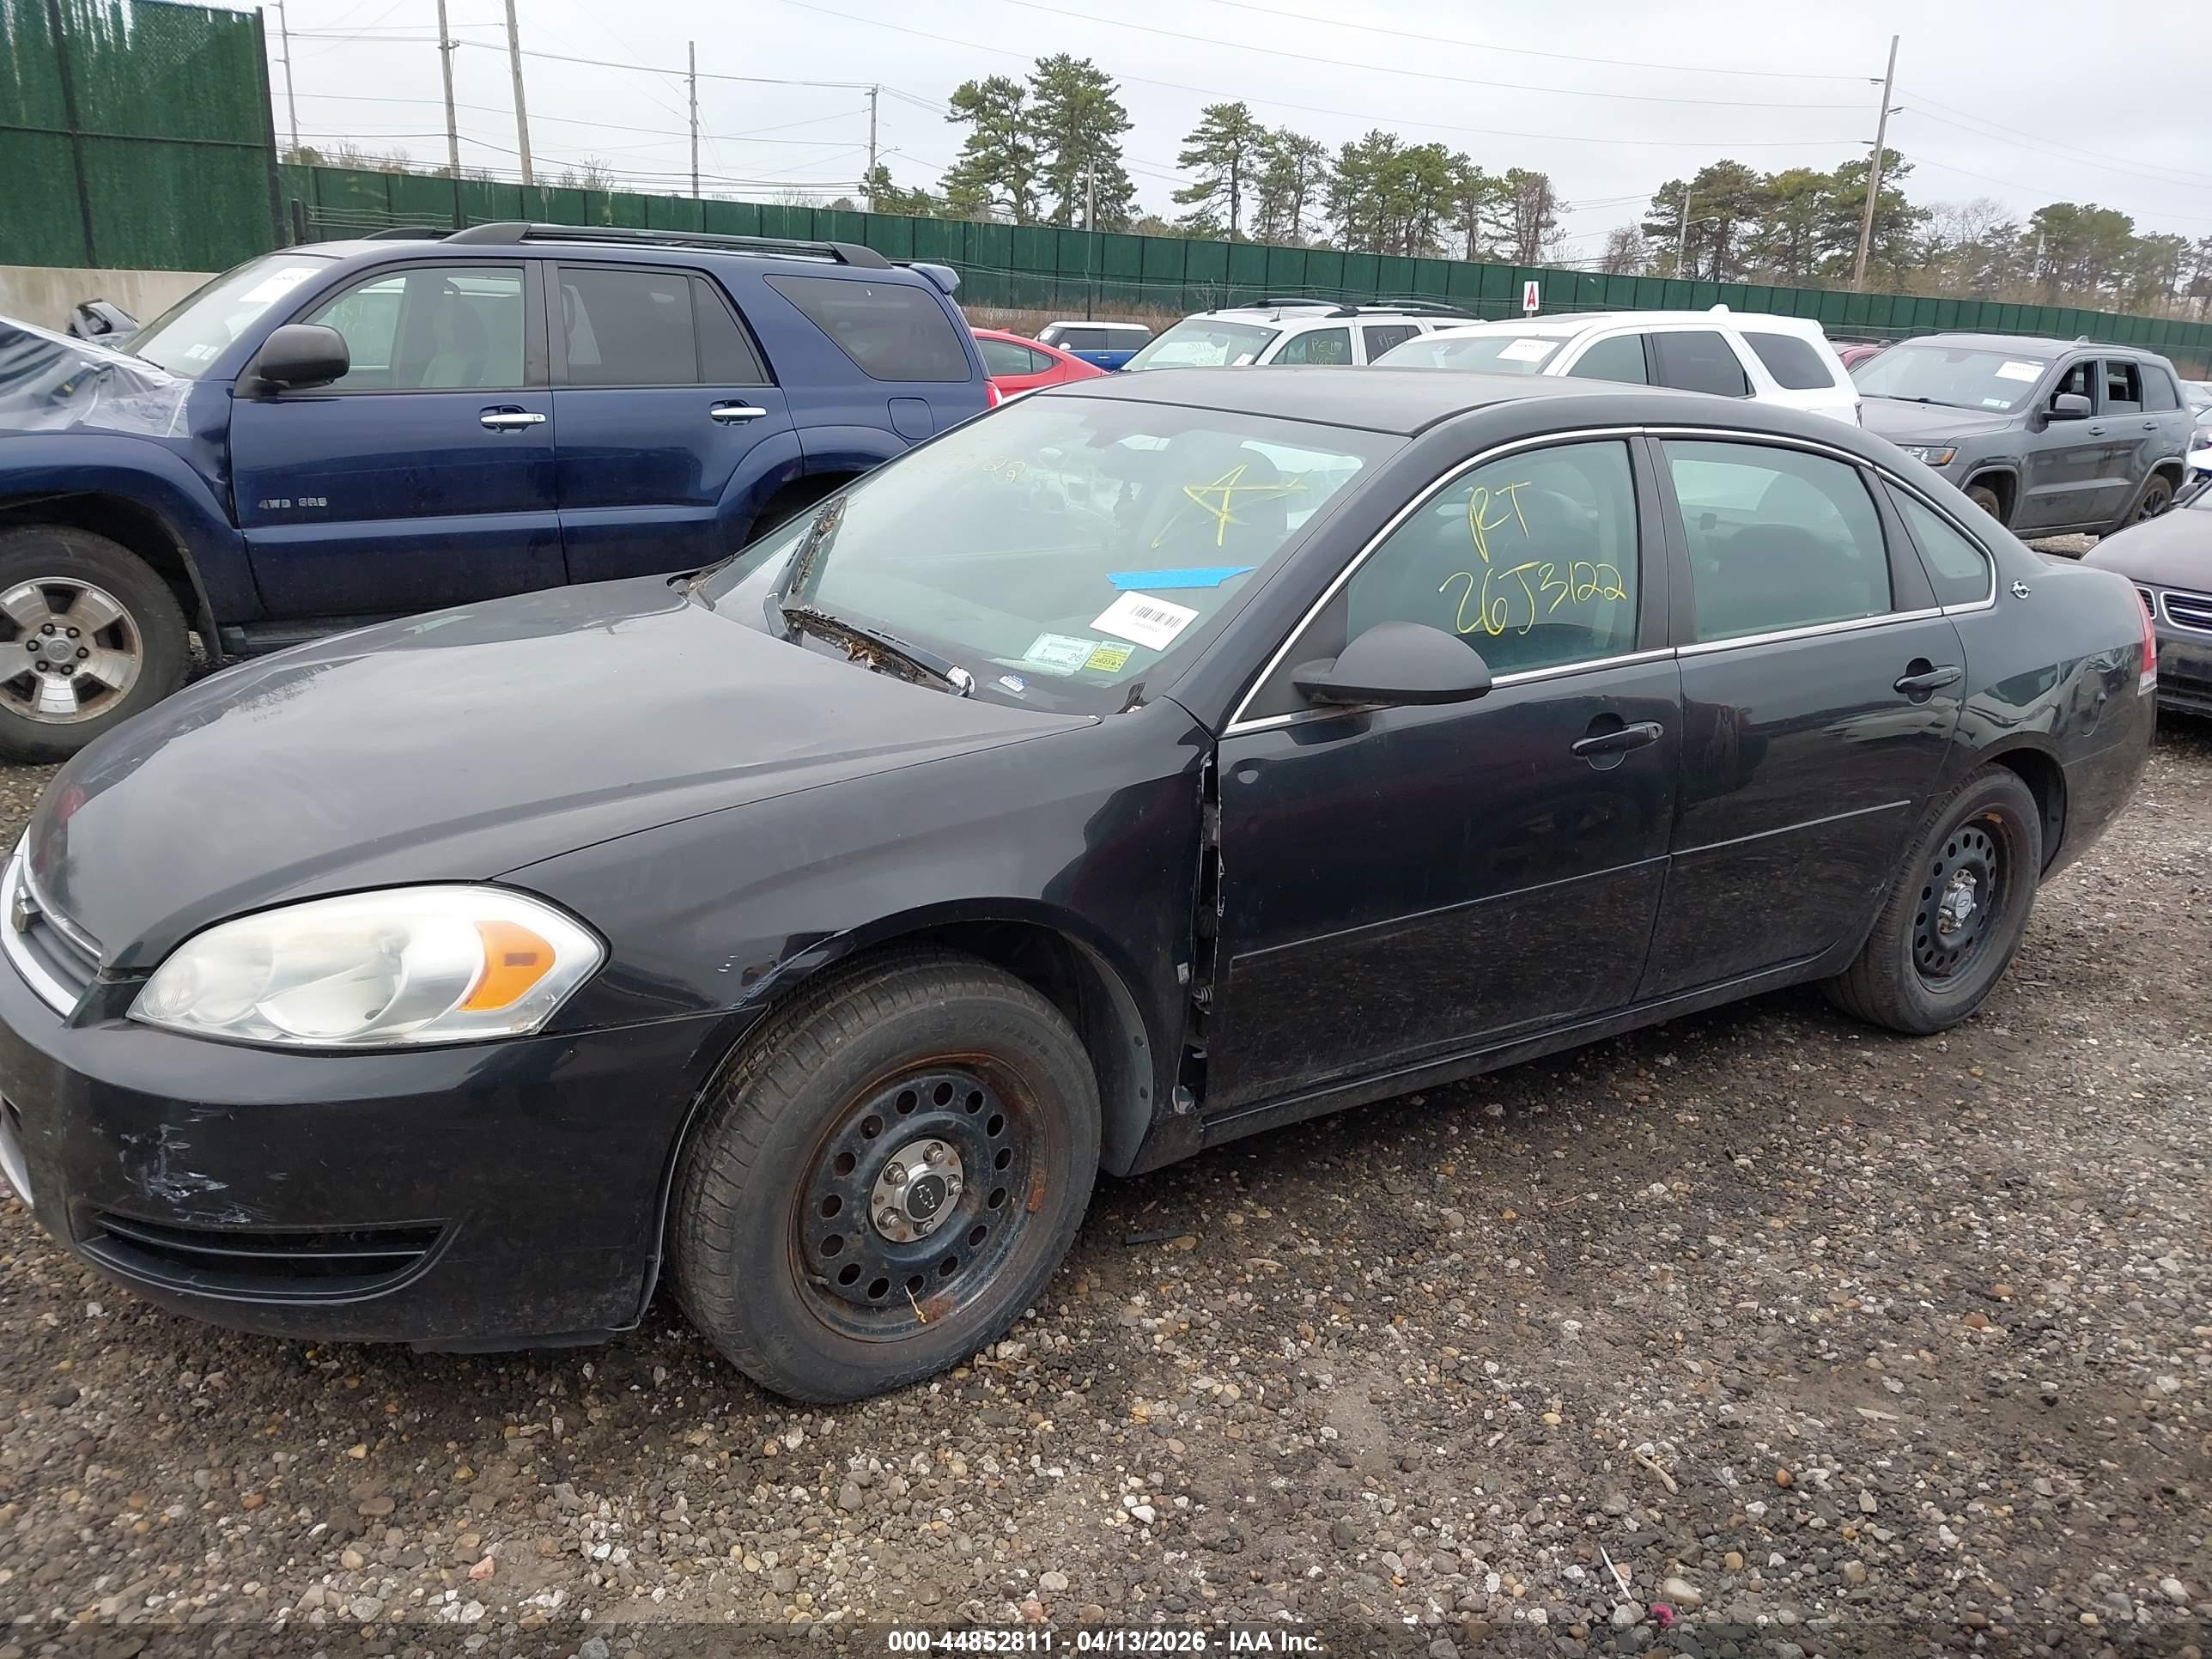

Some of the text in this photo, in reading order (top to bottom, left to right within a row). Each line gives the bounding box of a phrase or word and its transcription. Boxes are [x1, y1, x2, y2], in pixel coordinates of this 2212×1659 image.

[1526, 282, 1536, 307] A
[258, 499, 291, 508] 4WD
[1469, 481, 1533, 563] RT
